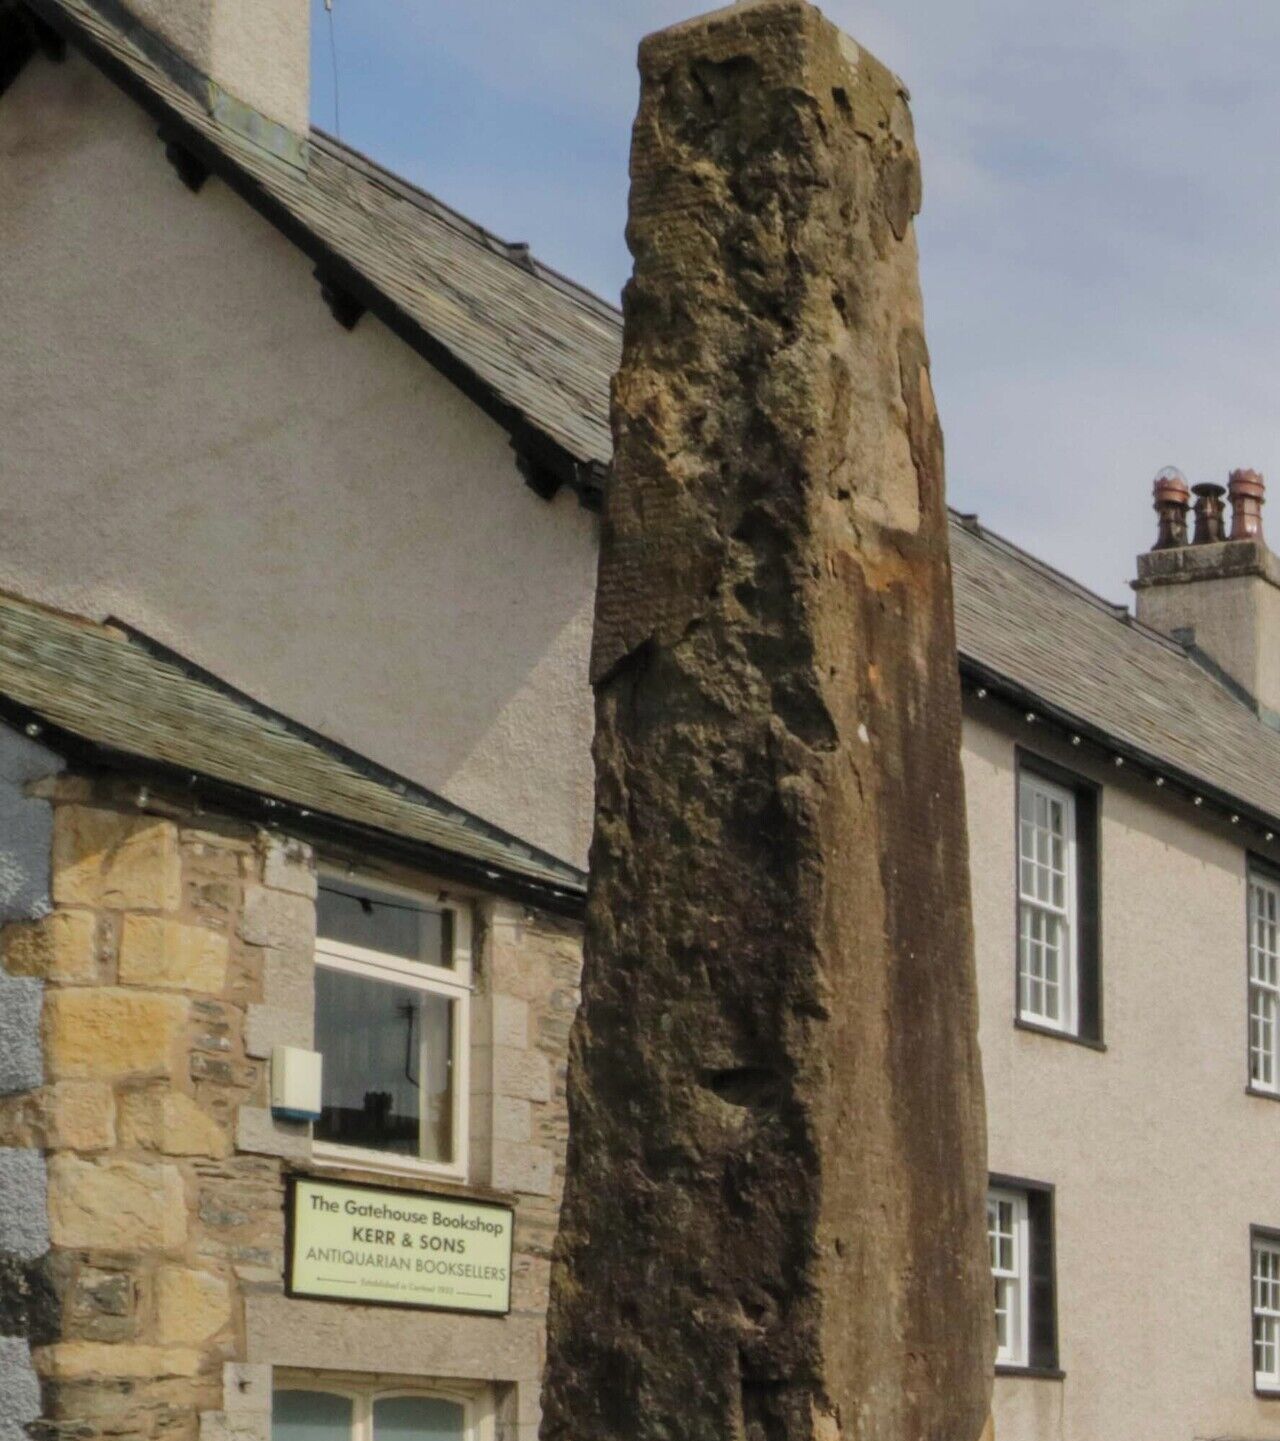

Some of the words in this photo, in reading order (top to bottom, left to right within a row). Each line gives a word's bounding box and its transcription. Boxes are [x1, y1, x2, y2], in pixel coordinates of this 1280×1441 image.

[310, 1194, 340, 1213] The
[344, 1199, 428, 1225] Gatehouse
[432, 1211, 505, 1238] Bookshop
[352, 1226, 396, 1246] KERR
[402, 1234, 413, 1249] &
[419, 1235, 467, 1254] SONS
[305, 1246, 412, 1272] ANTIQUARIAN
[415, 1258, 508, 1282] BOOKSELLERS
